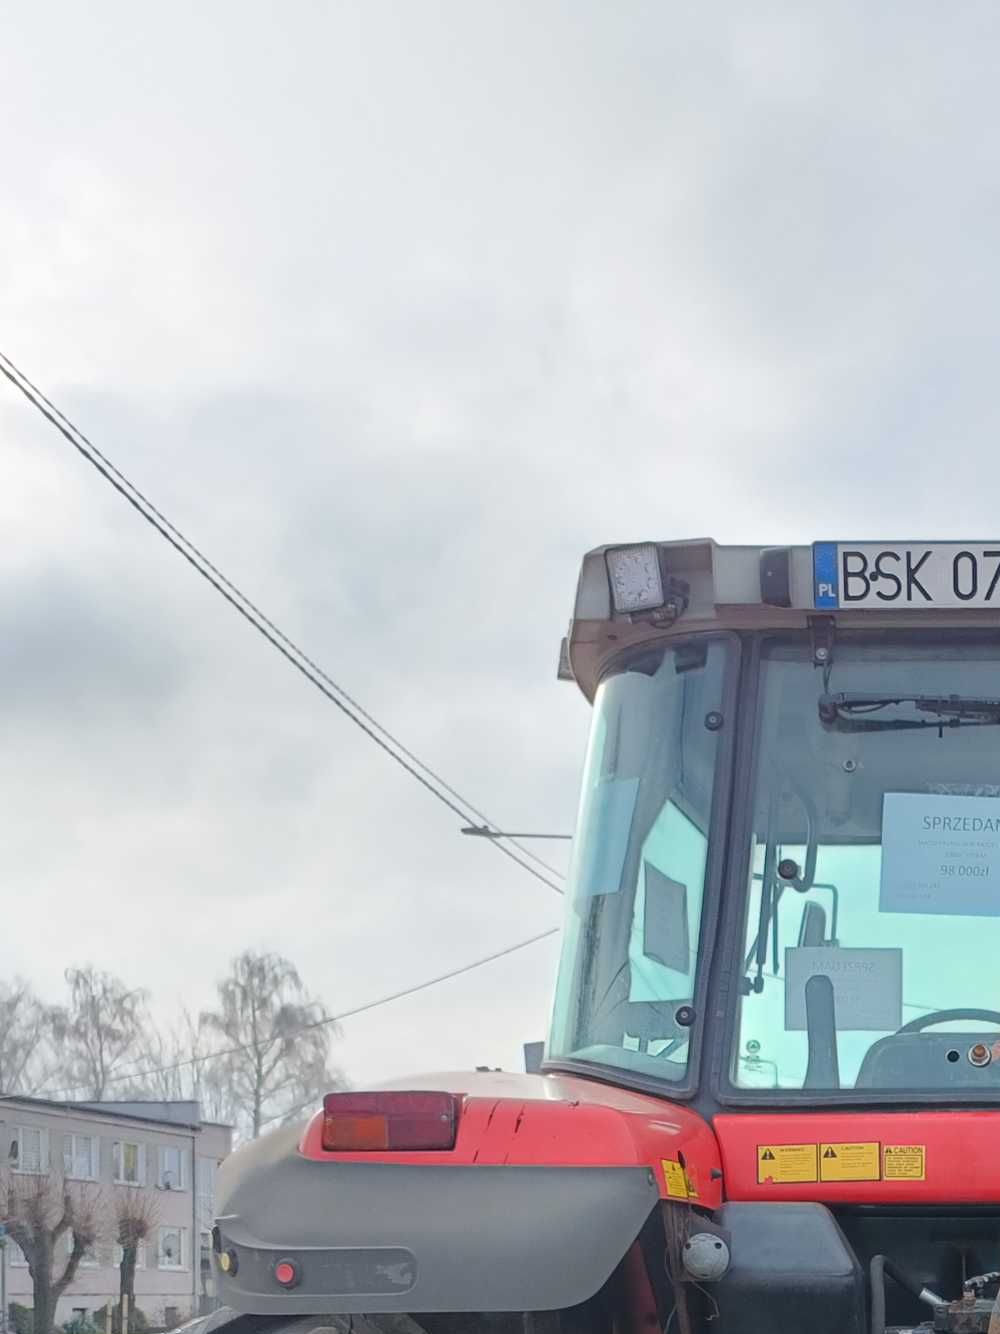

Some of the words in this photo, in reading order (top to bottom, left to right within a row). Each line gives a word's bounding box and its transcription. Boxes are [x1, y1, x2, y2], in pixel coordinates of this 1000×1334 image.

[842, 550, 933, 601] BSK
[818, 583, 836, 598] PL
[894, 1146, 921, 1154] CAUTION
